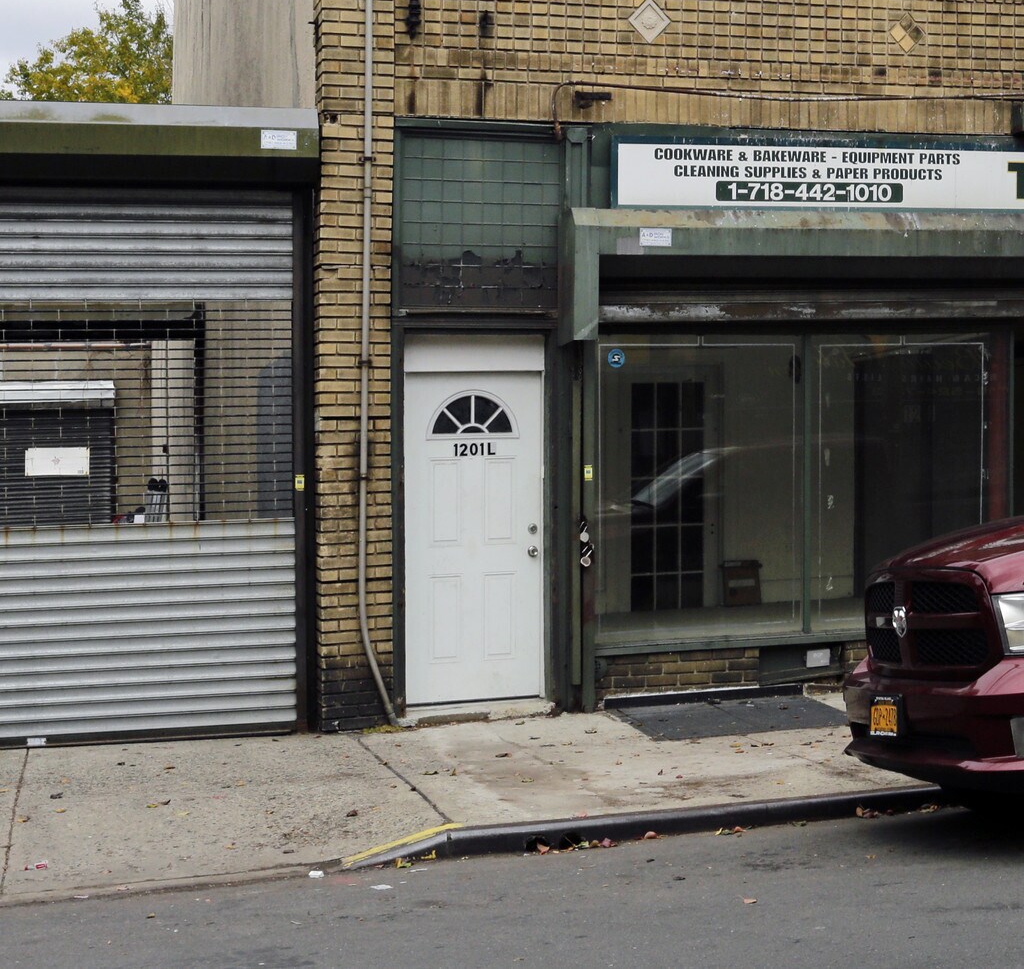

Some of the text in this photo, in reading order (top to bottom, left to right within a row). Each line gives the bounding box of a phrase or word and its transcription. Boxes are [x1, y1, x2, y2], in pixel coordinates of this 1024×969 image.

[654, 147, 733, 162] COOKWARE
[738, 149, 748, 162] &
[753, 149, 827, 163] BAKEWARE
[842, 151, 915, 165] EQUIPMENT
[919, 152, 961, 165] PARTS
[673, 165, 943, 181] CLEANING SUPPLIES & PAPER PRODUCTS
[728, 183, 892, 202] 1-718-442-1010
[453, 442, 496, 457] 1201L
